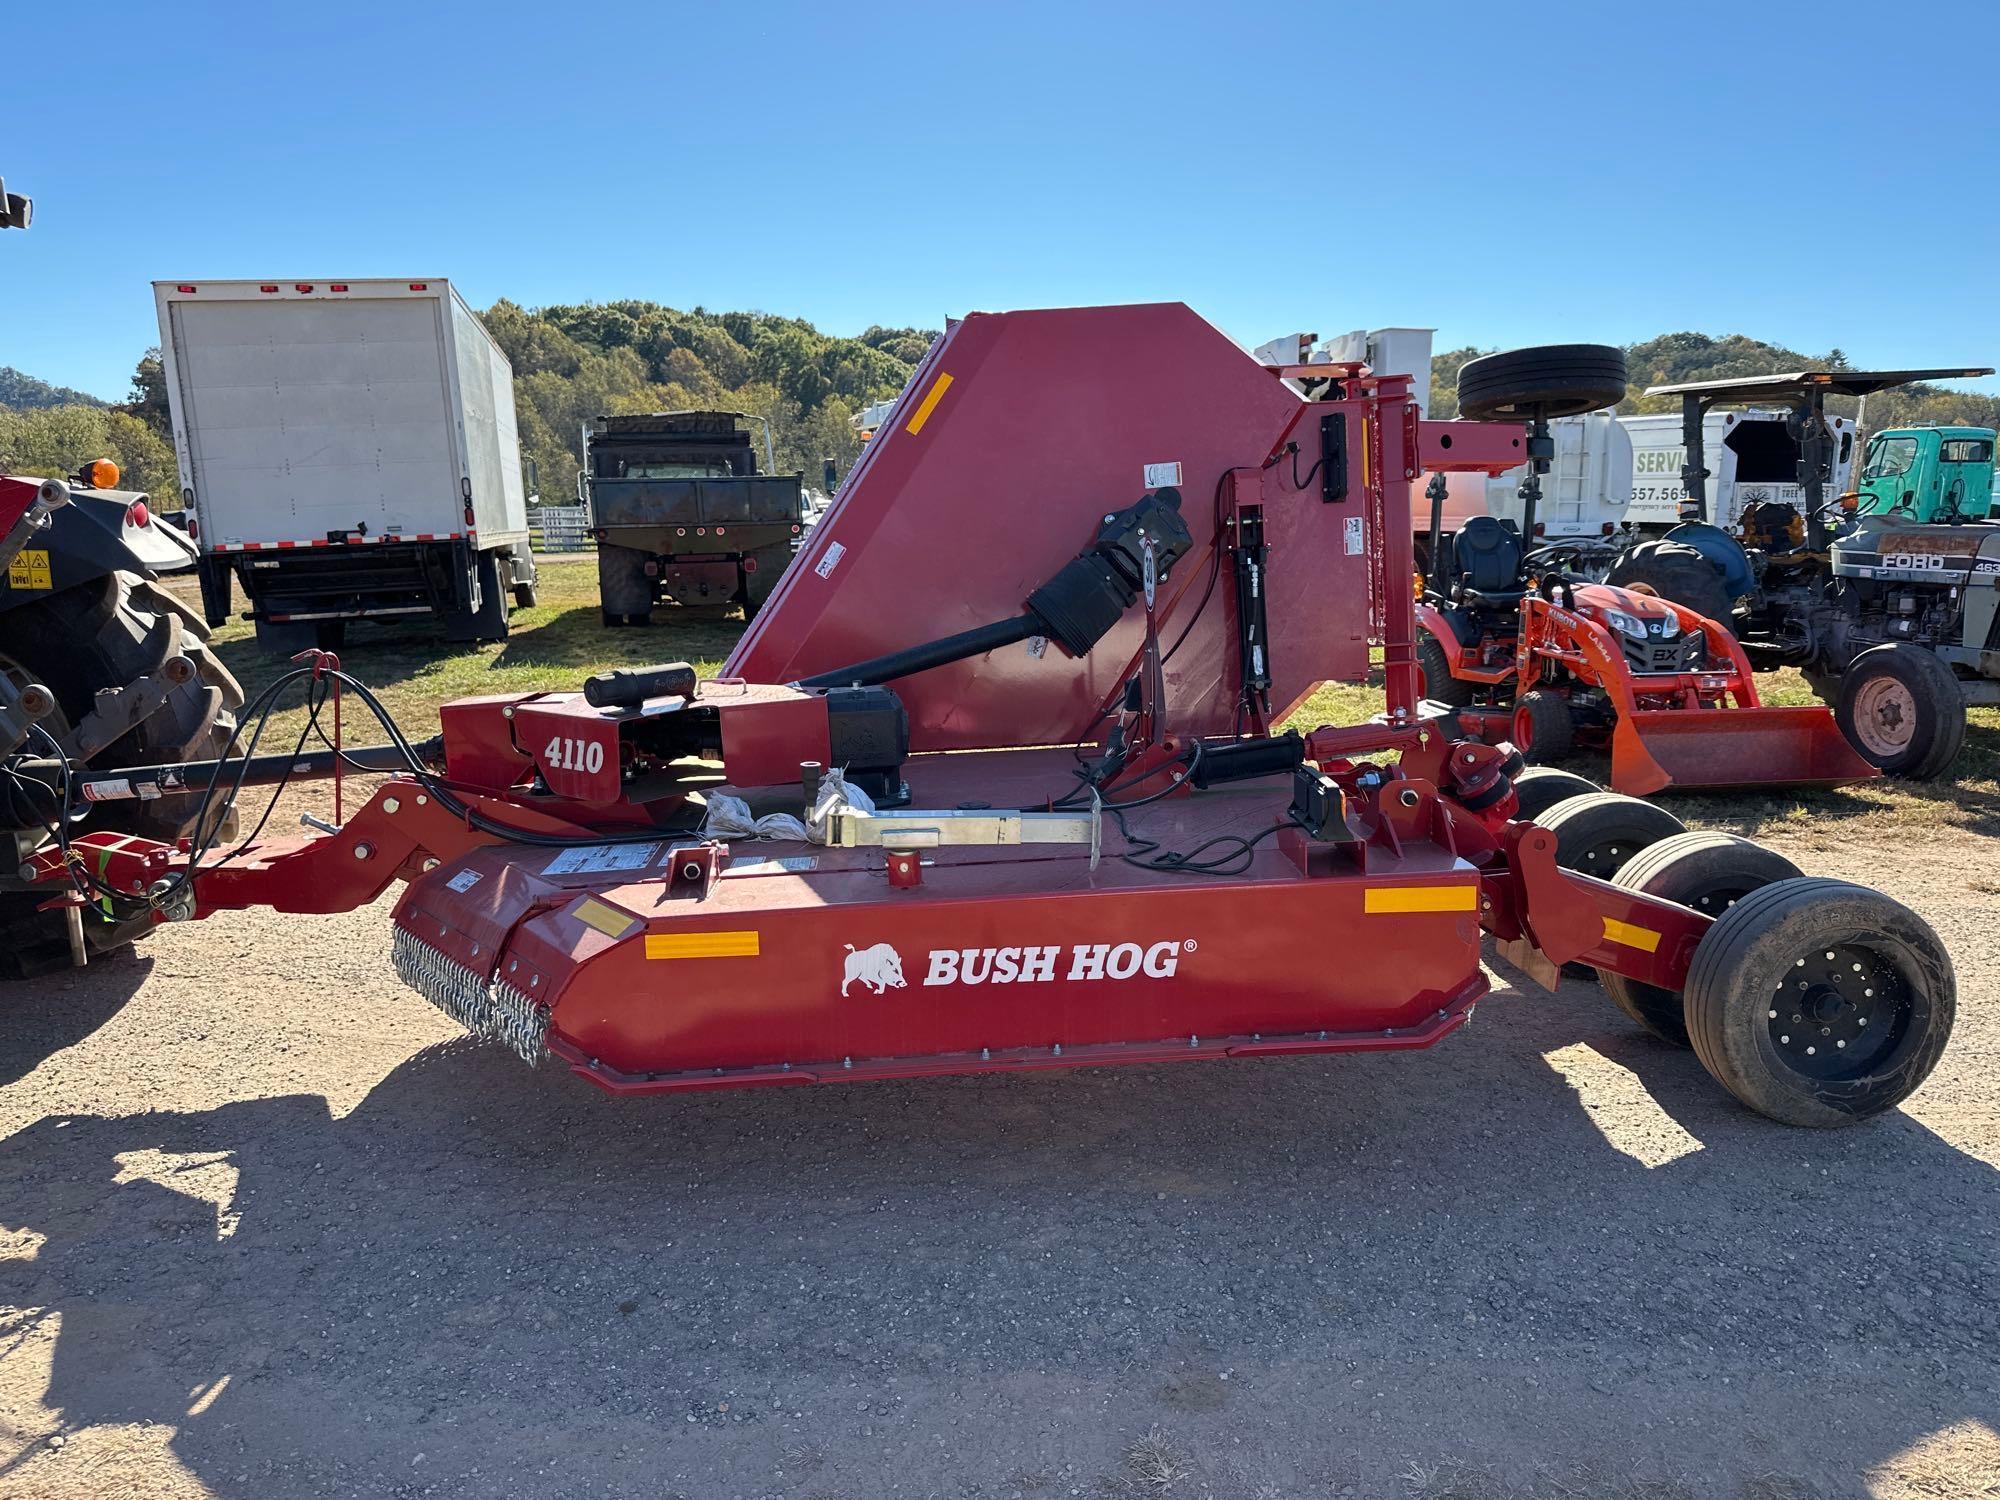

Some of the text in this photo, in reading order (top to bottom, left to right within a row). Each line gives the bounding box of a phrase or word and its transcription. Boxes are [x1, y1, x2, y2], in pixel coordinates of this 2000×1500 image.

[1882, 553, 1944, 569] FORD
[1548, 607, 1577, 629] KUBOTA
[1652, 649, 1678, 661] BX
[544, 736, 604, 774] 4110
[923, 946, 1060, 986] BUSH
